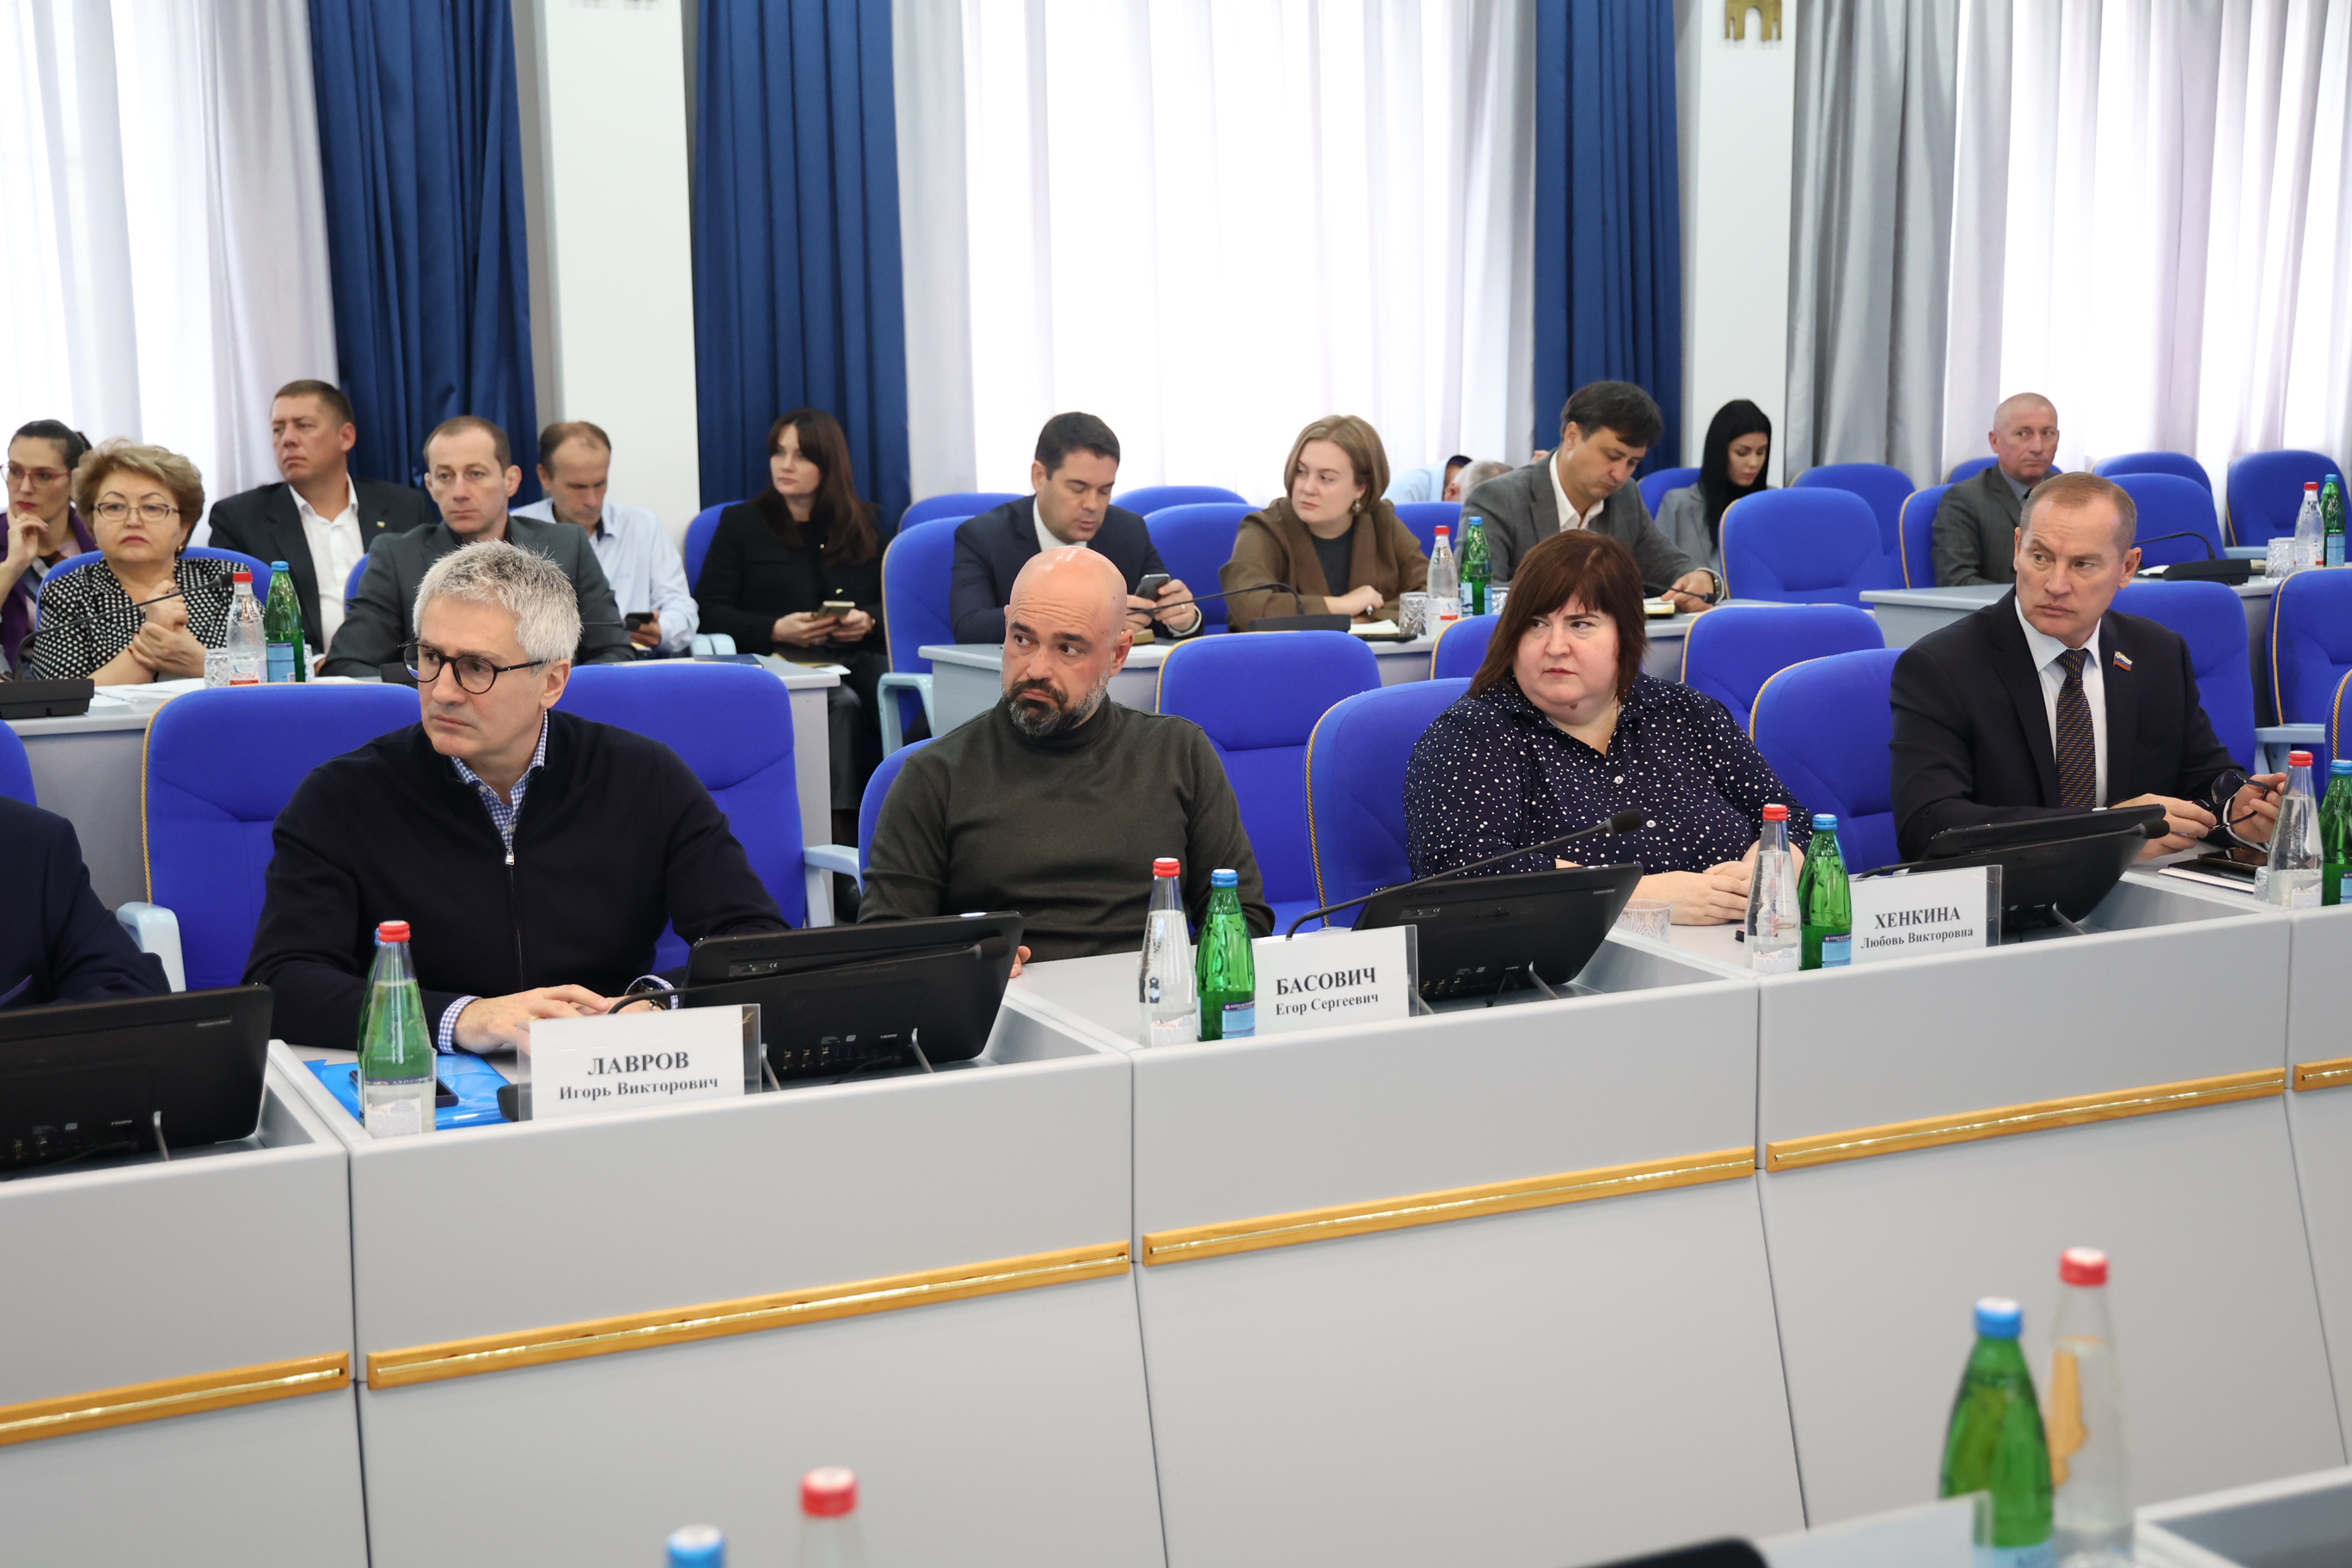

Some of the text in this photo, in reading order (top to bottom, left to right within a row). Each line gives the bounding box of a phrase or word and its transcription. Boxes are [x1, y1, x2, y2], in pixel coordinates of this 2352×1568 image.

[1874, 905, 1962, 929] ХЕНКИНА
[1860, 935, 1905, 949] Любовь
[1908, 928, 1974, 944] Викторовна
[1276, 966, 1376, 995] БАСОВИЧ
[1276, 993, 1379, 1016] Егор Сергеевич
[587, 1050, 689, 1075] ЛАВРОВ
[559, 1076, 719, 1101] Игорь Викторович
